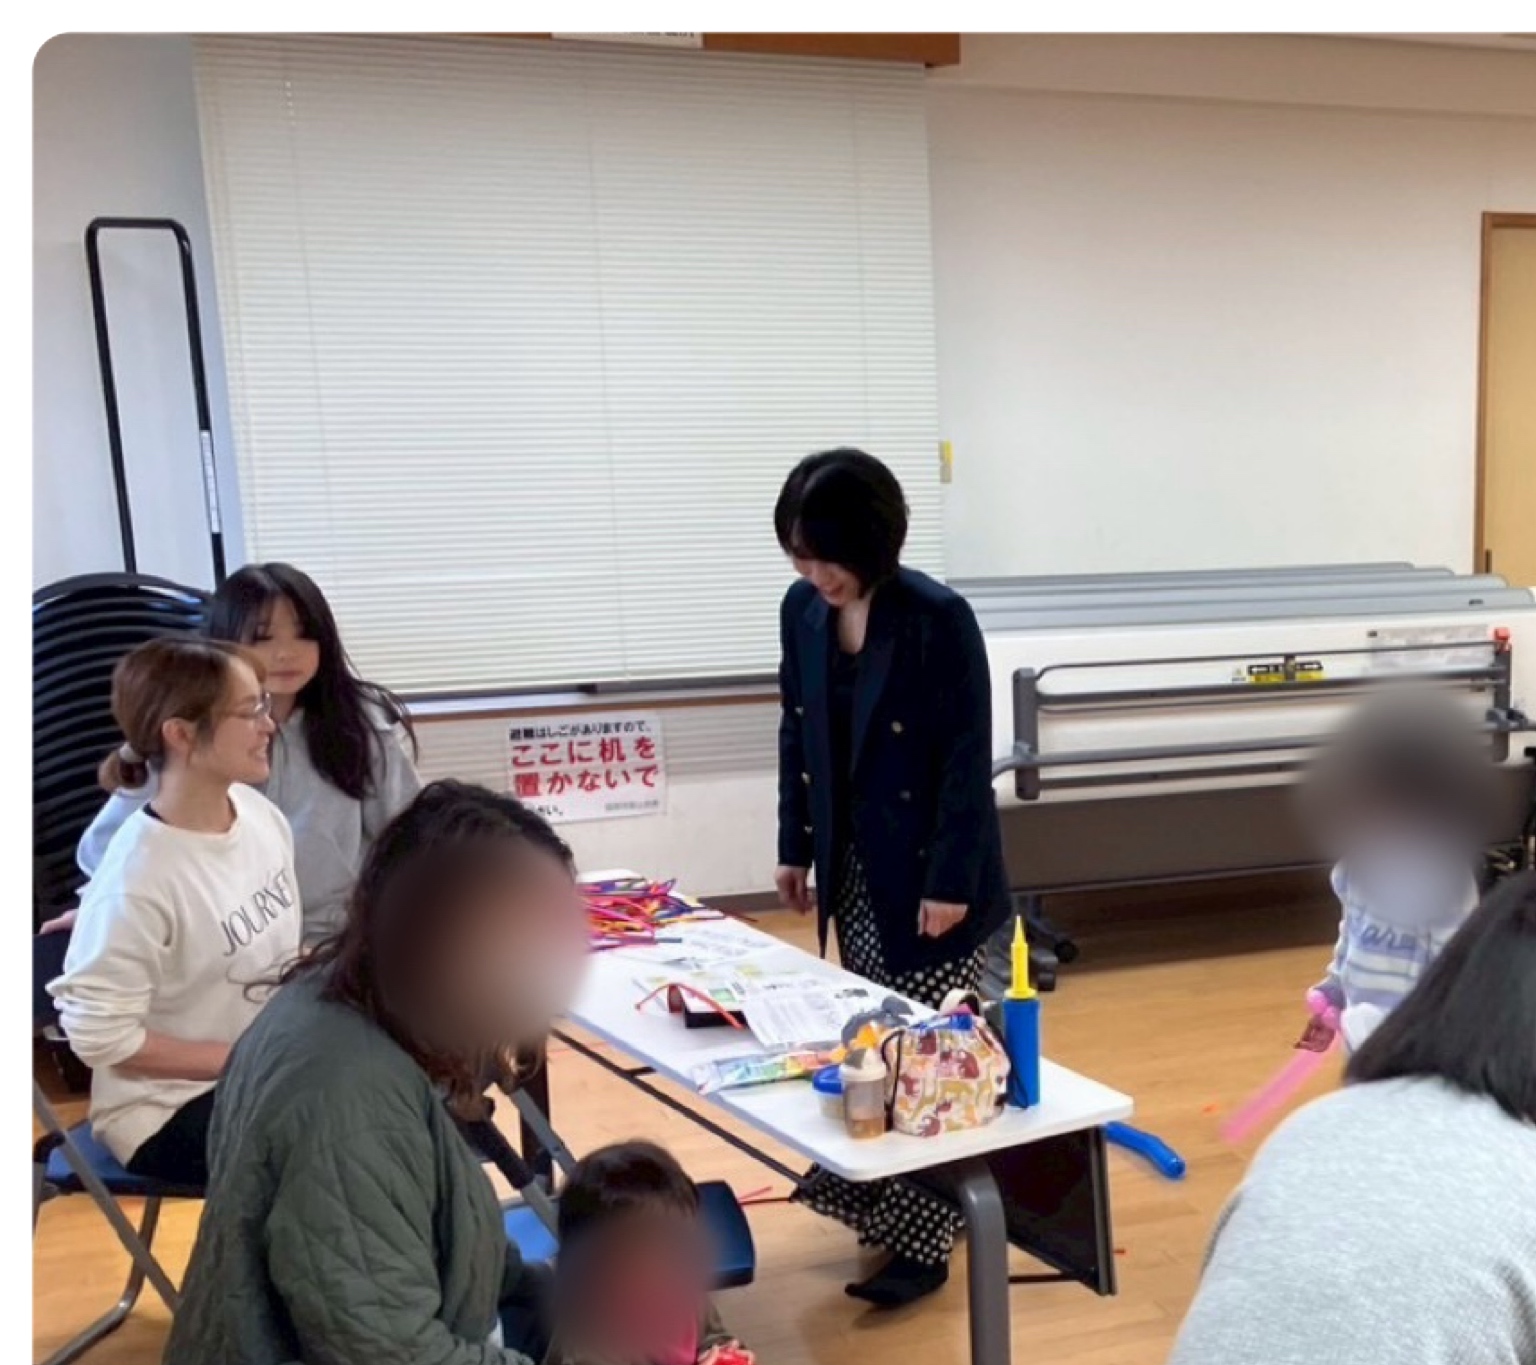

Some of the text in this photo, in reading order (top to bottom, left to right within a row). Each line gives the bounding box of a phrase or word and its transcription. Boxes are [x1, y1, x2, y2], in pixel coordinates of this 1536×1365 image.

[512, 736, 656, 767] ここに机を
[514, 764, 658, 798] 置かないで
[220, 868, 294, 957] JOURNE
